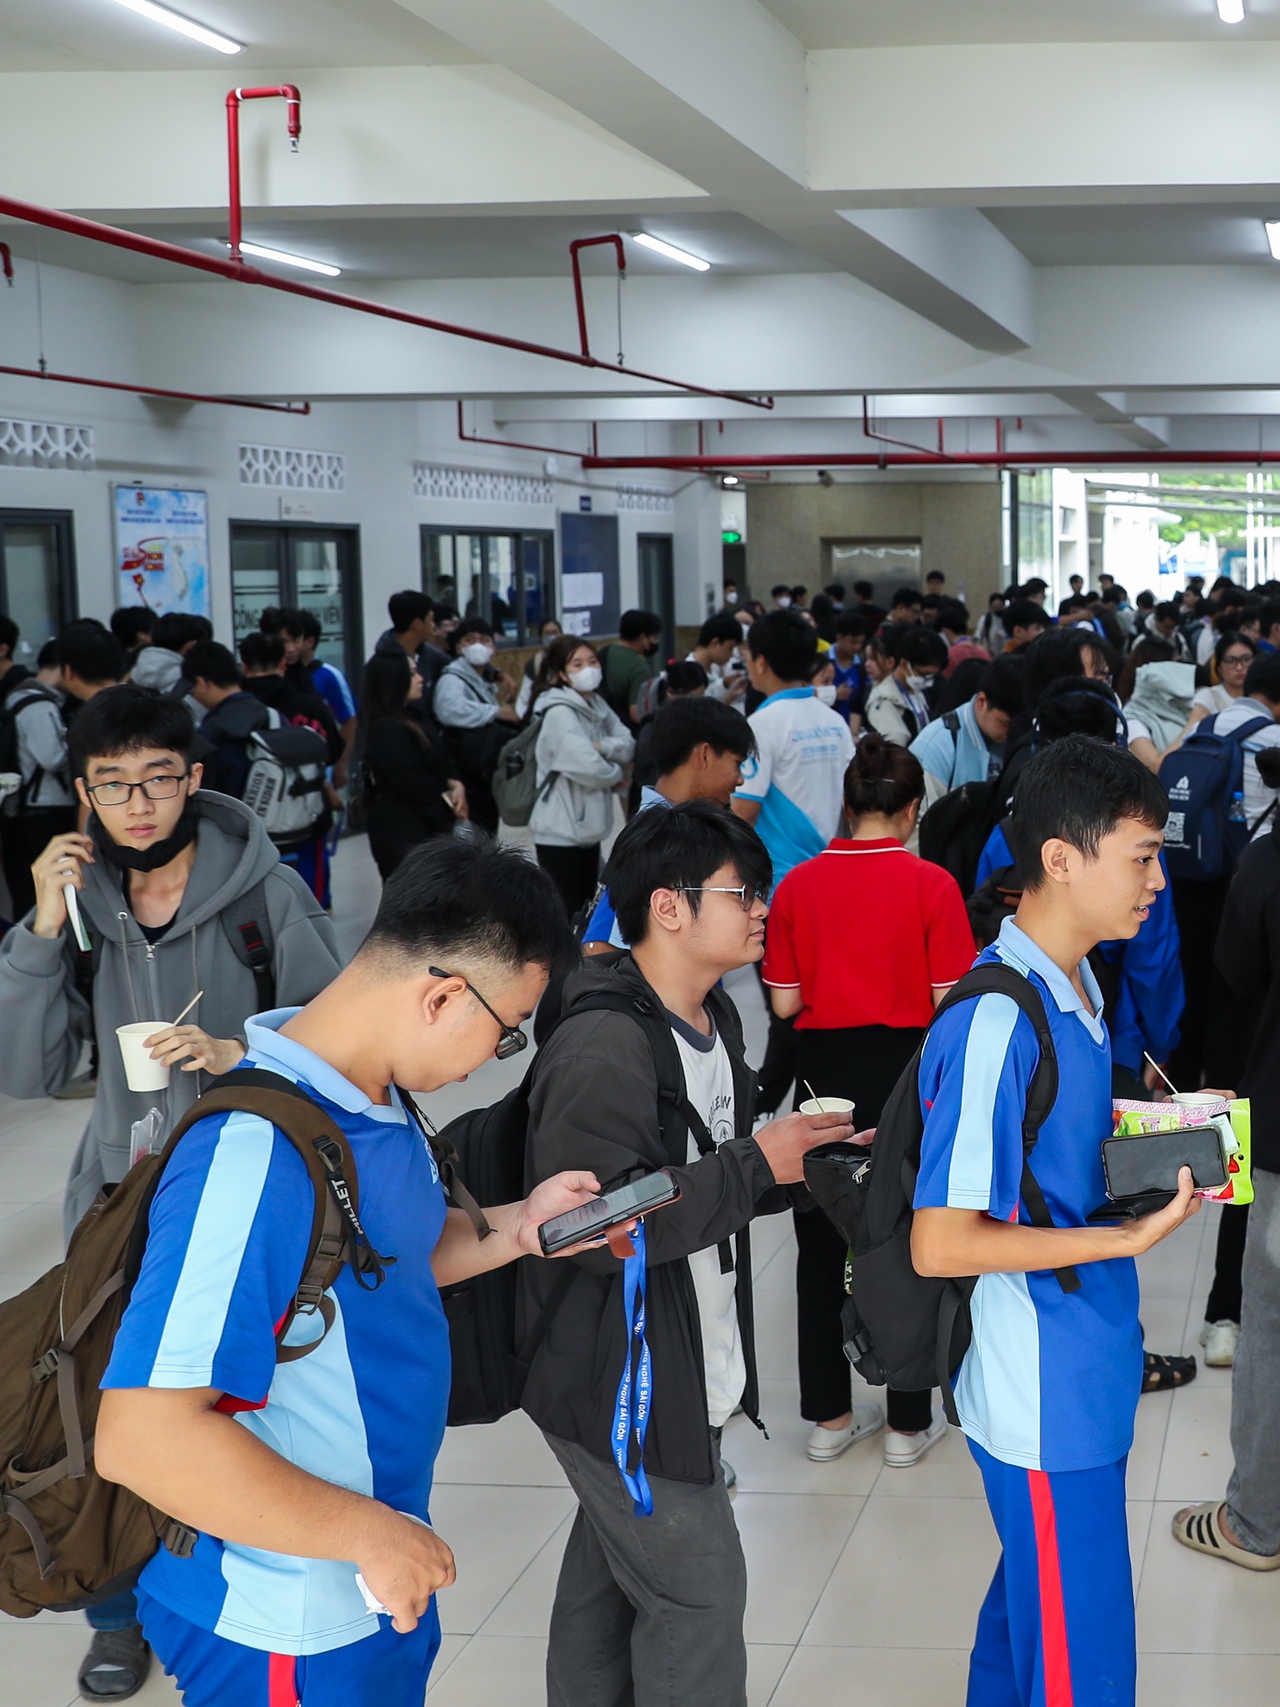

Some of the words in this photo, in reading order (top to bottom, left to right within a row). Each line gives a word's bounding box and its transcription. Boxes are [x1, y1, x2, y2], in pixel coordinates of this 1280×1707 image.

[331, 1179, 364, 1235] MILLET
[640, 1365, 649, 1387] NGHỆ
[619, 1384, 629, 1407] NGHỆ
[639, 1390, 649, 1403] SÀI
[619, 1407, 629, 1420] SÀI
[637, 1404, 646, 1421] GÒN
[616, 1421, 626, 1440] GÒN
